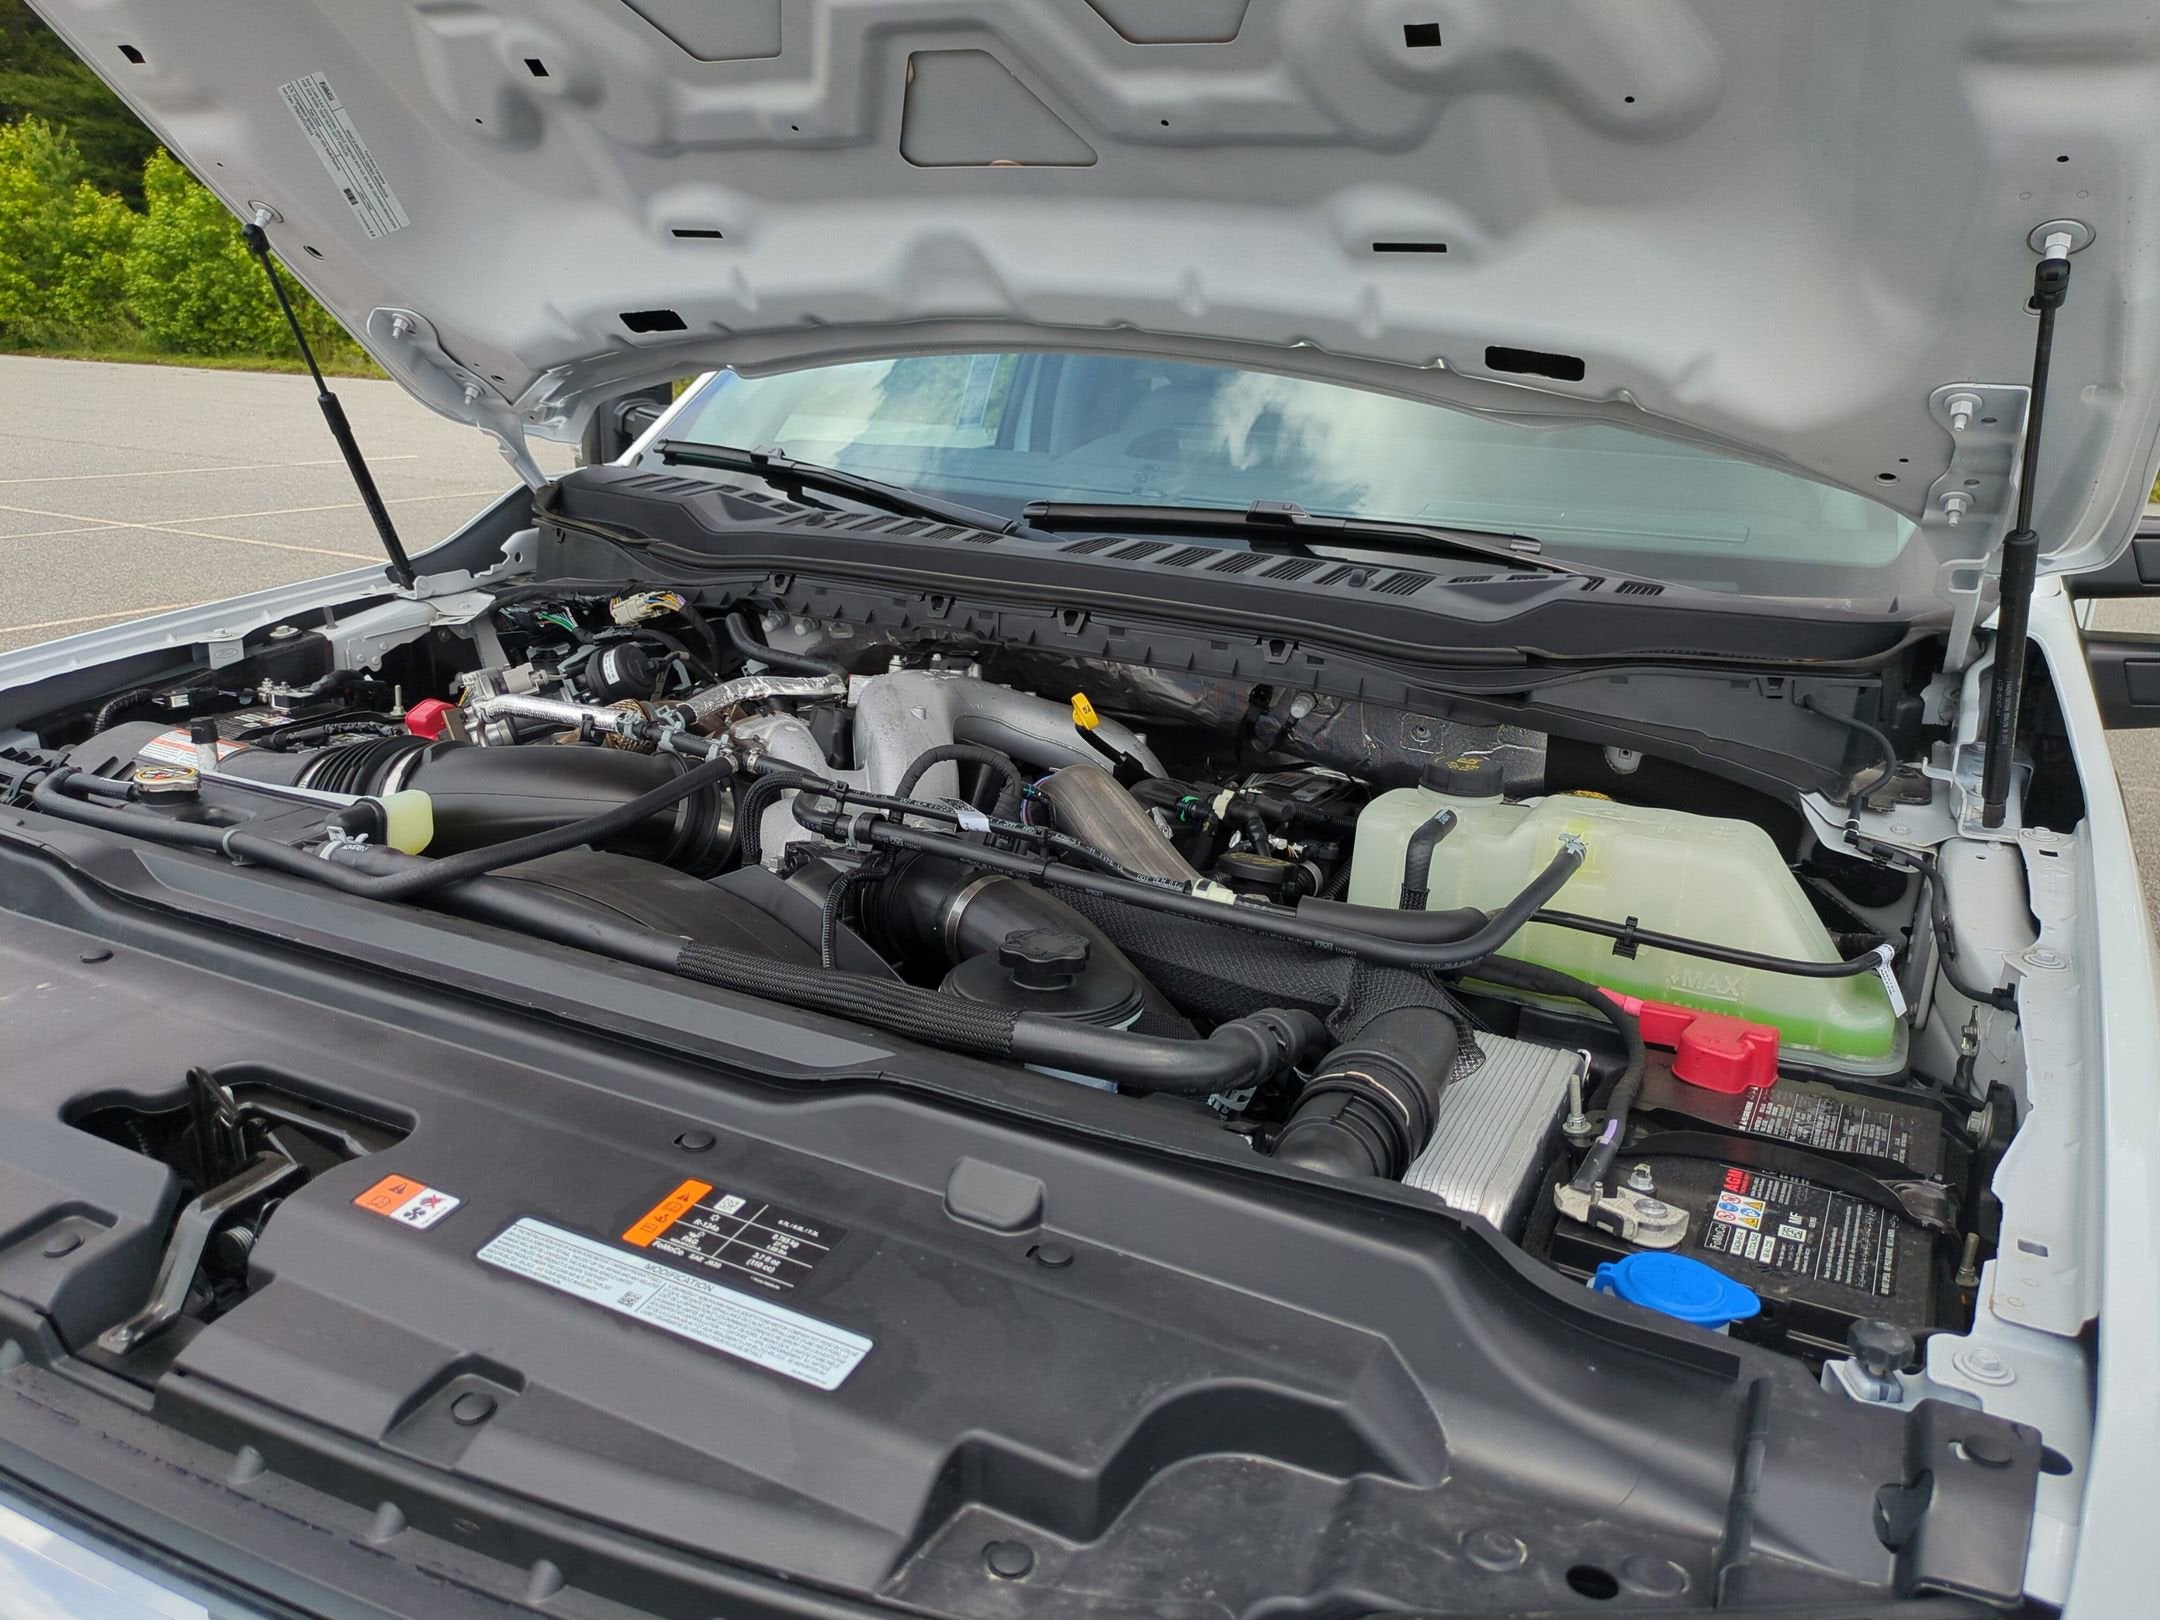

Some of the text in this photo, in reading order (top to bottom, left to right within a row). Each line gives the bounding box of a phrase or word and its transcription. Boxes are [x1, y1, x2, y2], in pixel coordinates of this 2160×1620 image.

[1681, 968, 1741, 997] MAX
[1723, 1168, 1745, 1193] AGM
[652, 1240, 684, 1256] FoMoCo
[1709, 1223, 1727, 1249] FoMoCo
[643, 1263, 715, 1292] MODIFICATION
